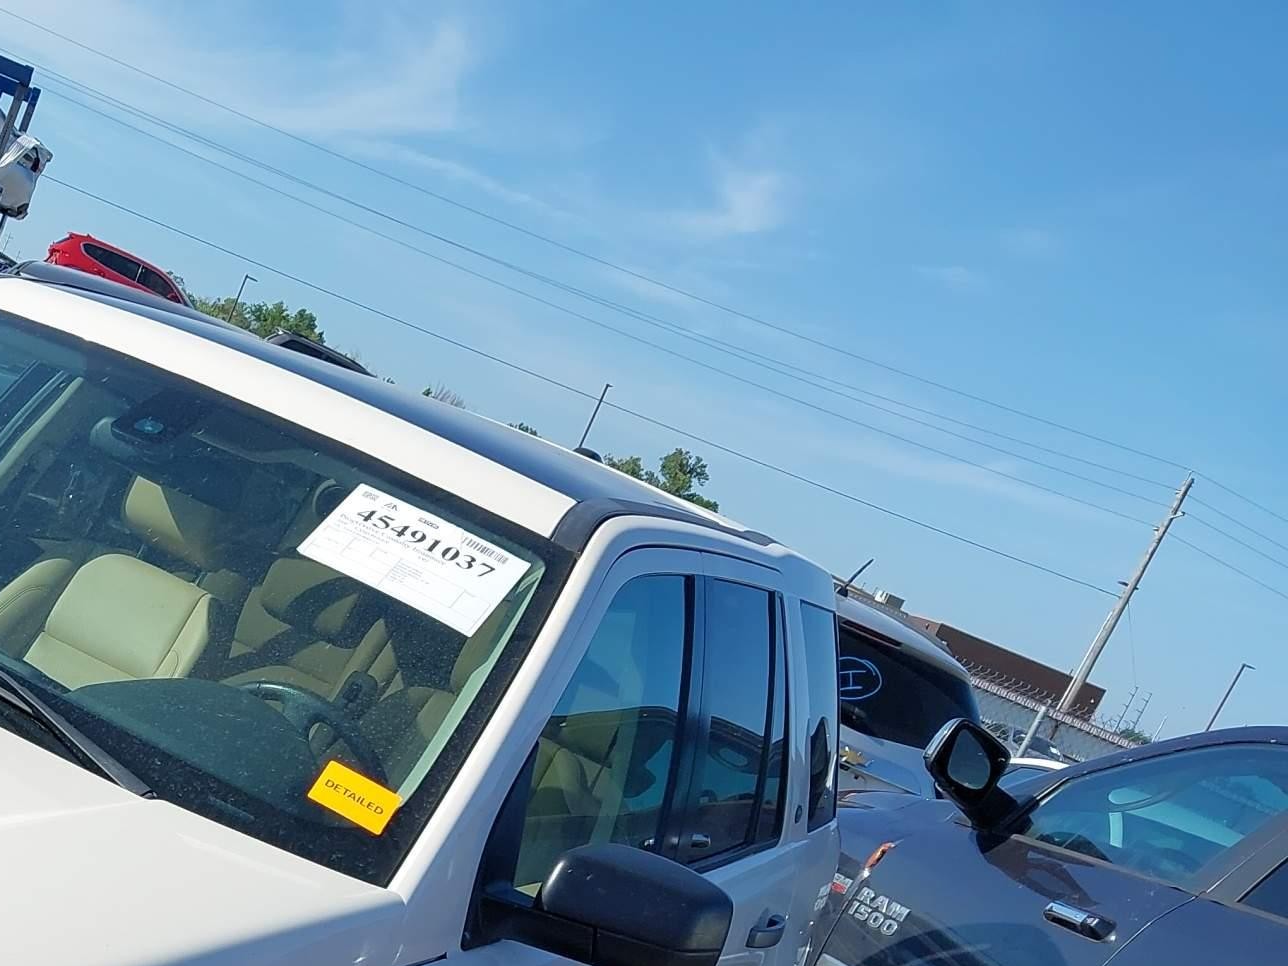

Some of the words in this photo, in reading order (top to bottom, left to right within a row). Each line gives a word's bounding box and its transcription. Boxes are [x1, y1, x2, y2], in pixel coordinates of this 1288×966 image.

[357, 509, 496, 577] 45491037
[324, 778, 385, 815] DETAILED
[848, 900, 898, 936] 1500
[856, 886, 912, 922] RAM
